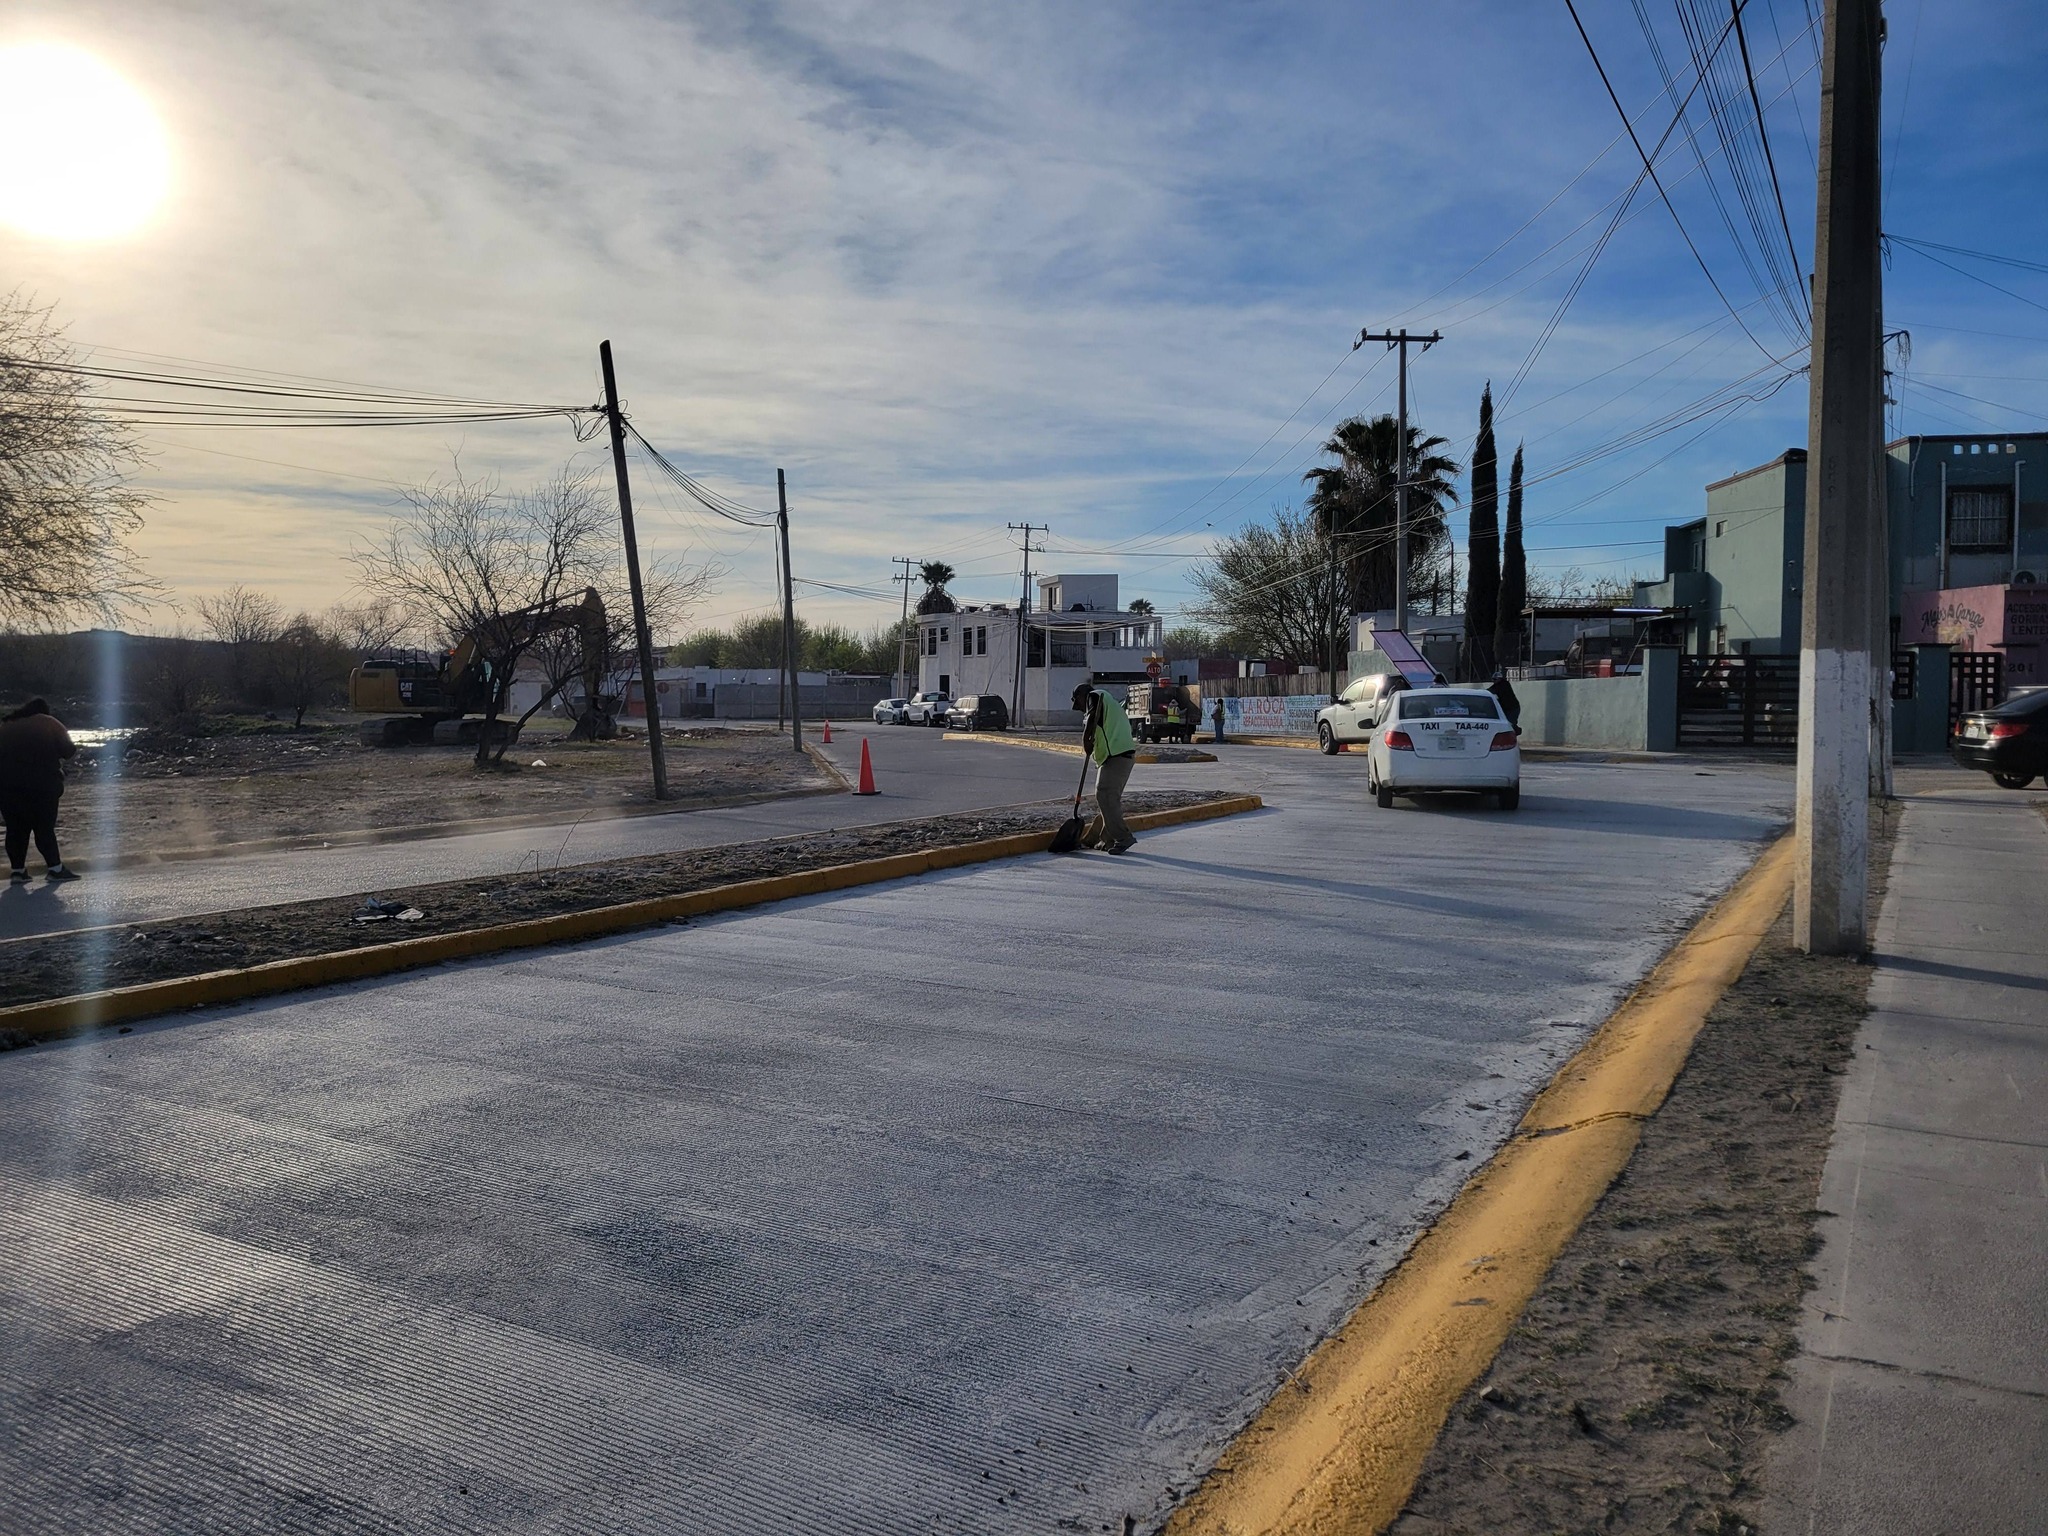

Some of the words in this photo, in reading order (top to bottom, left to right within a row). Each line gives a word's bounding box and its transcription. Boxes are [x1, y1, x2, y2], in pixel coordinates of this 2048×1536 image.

[1953, 602, 1985, 635] Garage
[2012, 625, 2048, 635] LENTE
[400, 682, 413, 691] CAT
[1242, 699, 1254, 714] LA
[1256, 697, 1286, 714] ROCA
[1420, 722, 1440, 730] TAXI
[1455, 722, 1489, 731] TAA-440
